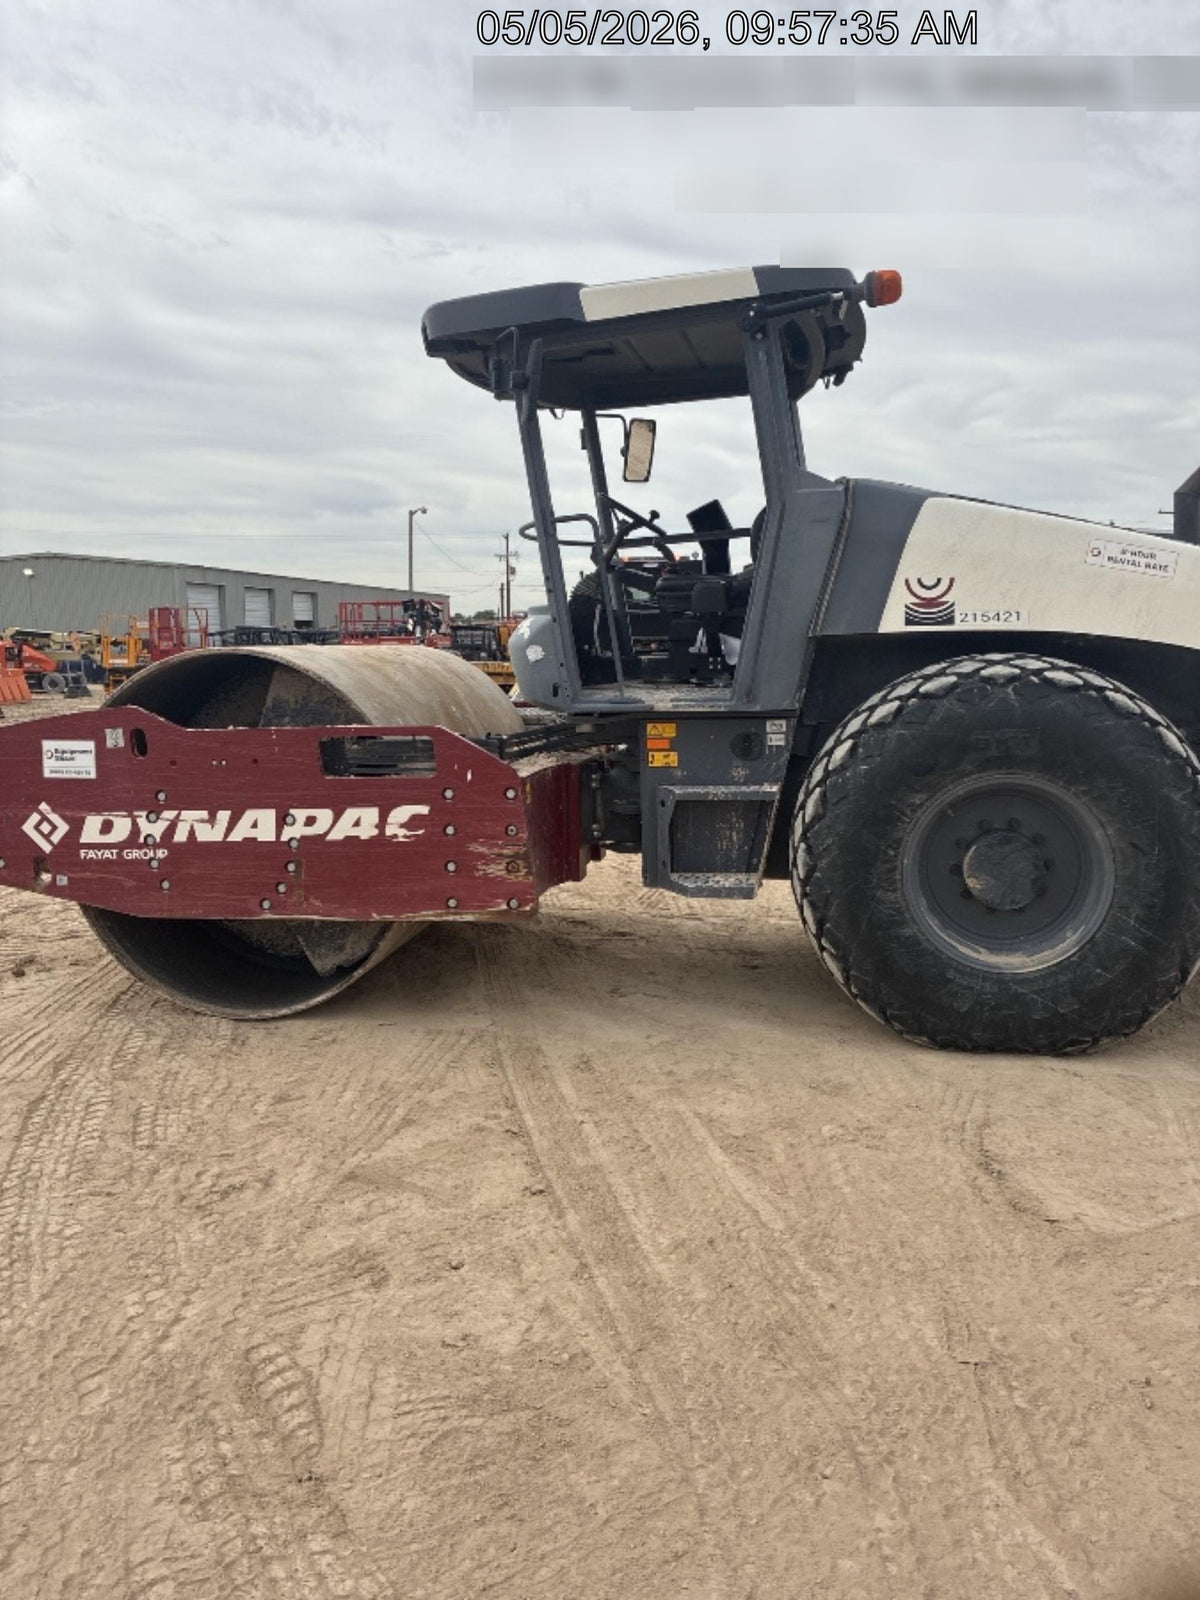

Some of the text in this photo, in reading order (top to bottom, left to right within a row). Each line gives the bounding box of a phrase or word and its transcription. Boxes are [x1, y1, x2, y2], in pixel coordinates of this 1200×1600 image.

[959, 610, 1021, 623] 215421
[79, 804, 431, 843] DYNAPAC
[79, 848, 168, 861] FAYAT GROUP
